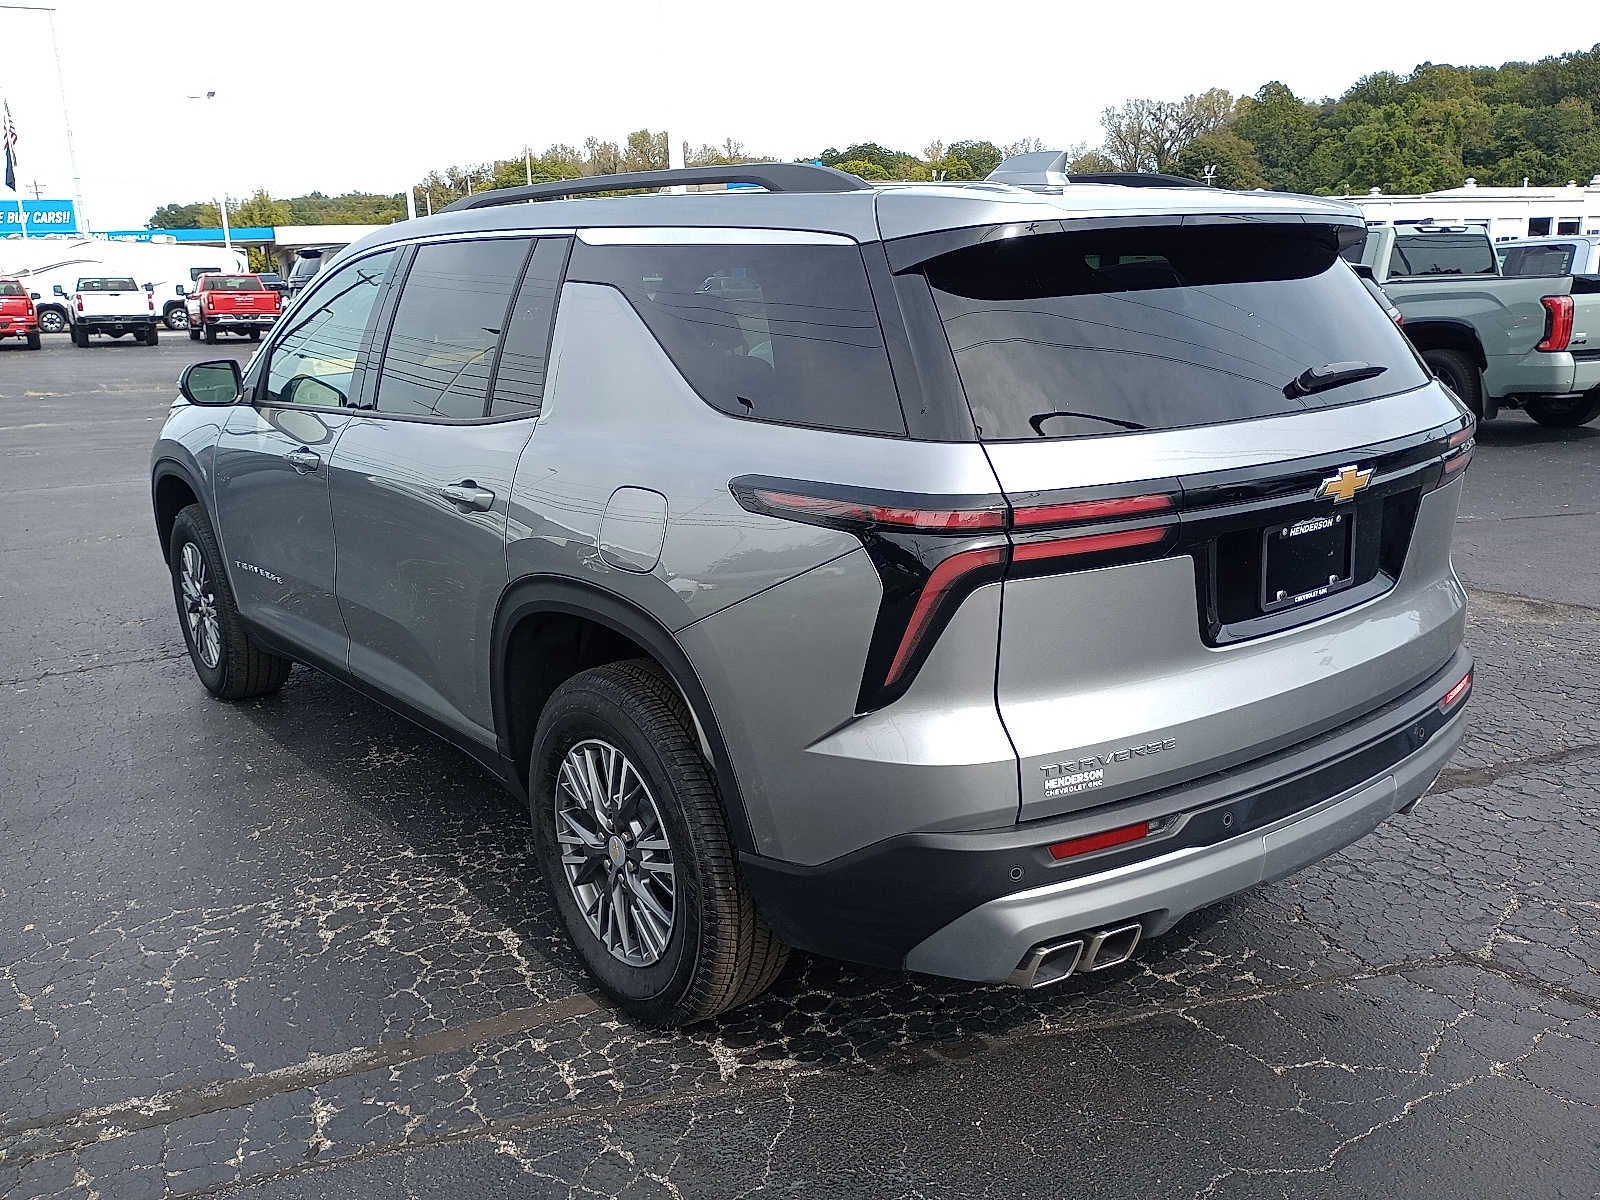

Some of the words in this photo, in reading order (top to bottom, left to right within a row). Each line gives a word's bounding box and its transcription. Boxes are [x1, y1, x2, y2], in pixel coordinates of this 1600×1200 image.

[7, 211, 30, 224] BUY
[33, 211, 71, 224] CARS!!
[1289, 518, 1334, 537] HENDERSON
[1039, 737, 1177, 777] TRAVERSE
[1044, 768, 1104, 790] HENDERSON
[1044, 783, 1086, 797] CHEVROLET
[1087, 779, 1103, 788] GMC
